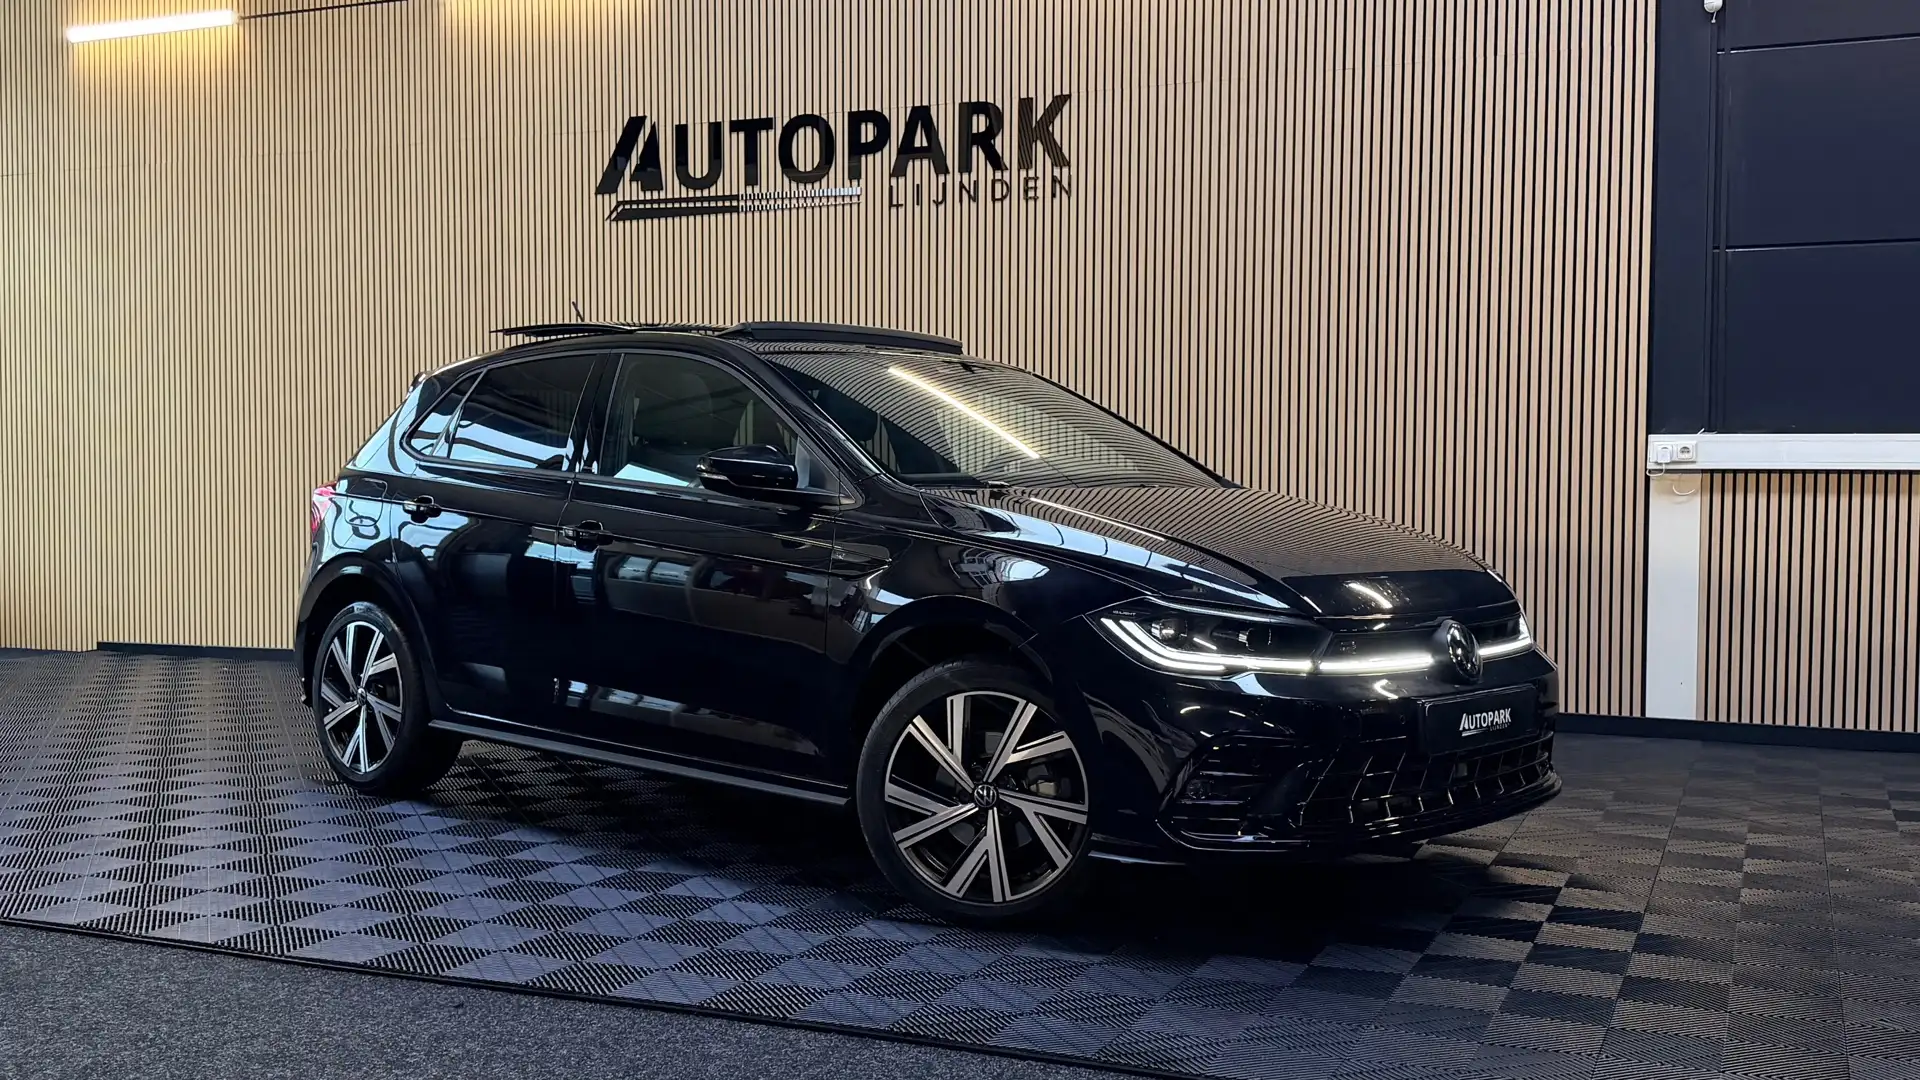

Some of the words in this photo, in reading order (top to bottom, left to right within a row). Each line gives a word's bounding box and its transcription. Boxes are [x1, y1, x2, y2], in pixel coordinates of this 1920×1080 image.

[595, 94, 1072, 195] AUTOPARK
[888, 173, 1072, 209] LIJNDEN
[1459, 708, 1512, 730] AUTOPARK
